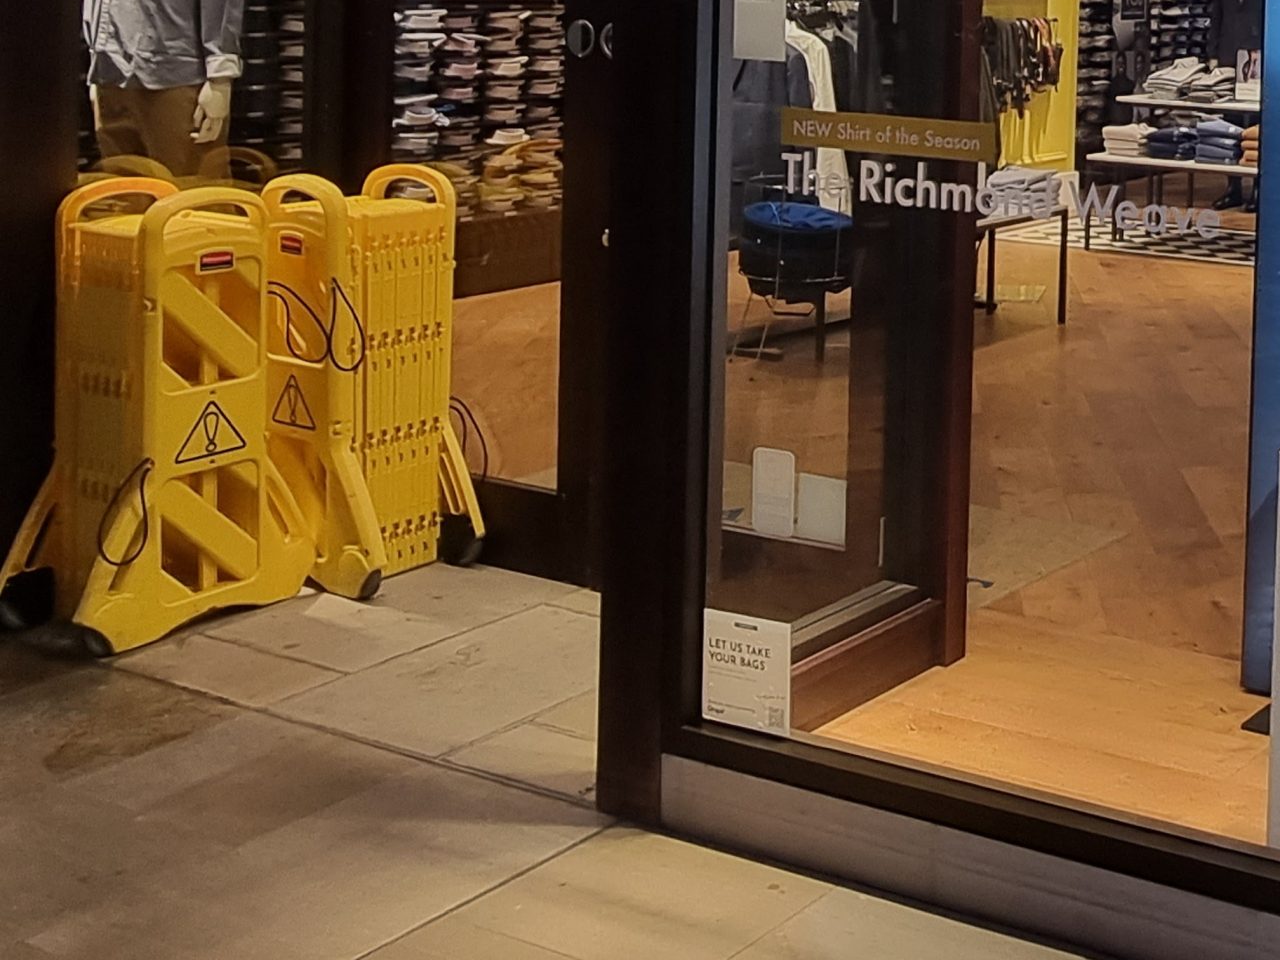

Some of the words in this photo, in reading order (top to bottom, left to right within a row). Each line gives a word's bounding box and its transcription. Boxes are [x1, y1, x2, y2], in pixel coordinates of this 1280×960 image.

[793, 120, 832, 138] NEW
[837, 123, 871, 141] Shirt
[875, 126, 891, 144] of
[895, 127, 919, 146] the
[924, 130, 980, 151] Season
[781, 151, 843, 197] The
[860, 159, 1052, 220] Richmond
[1069, 179, 1221, 240] Weave
[708, 637, 726, 649] LET
[730, 641, 743, 653] US
[746, 645, 771, 659] TAKE
[708, 650, 736, 664] YOUR
[740, 657, 766, 671] BAGS
